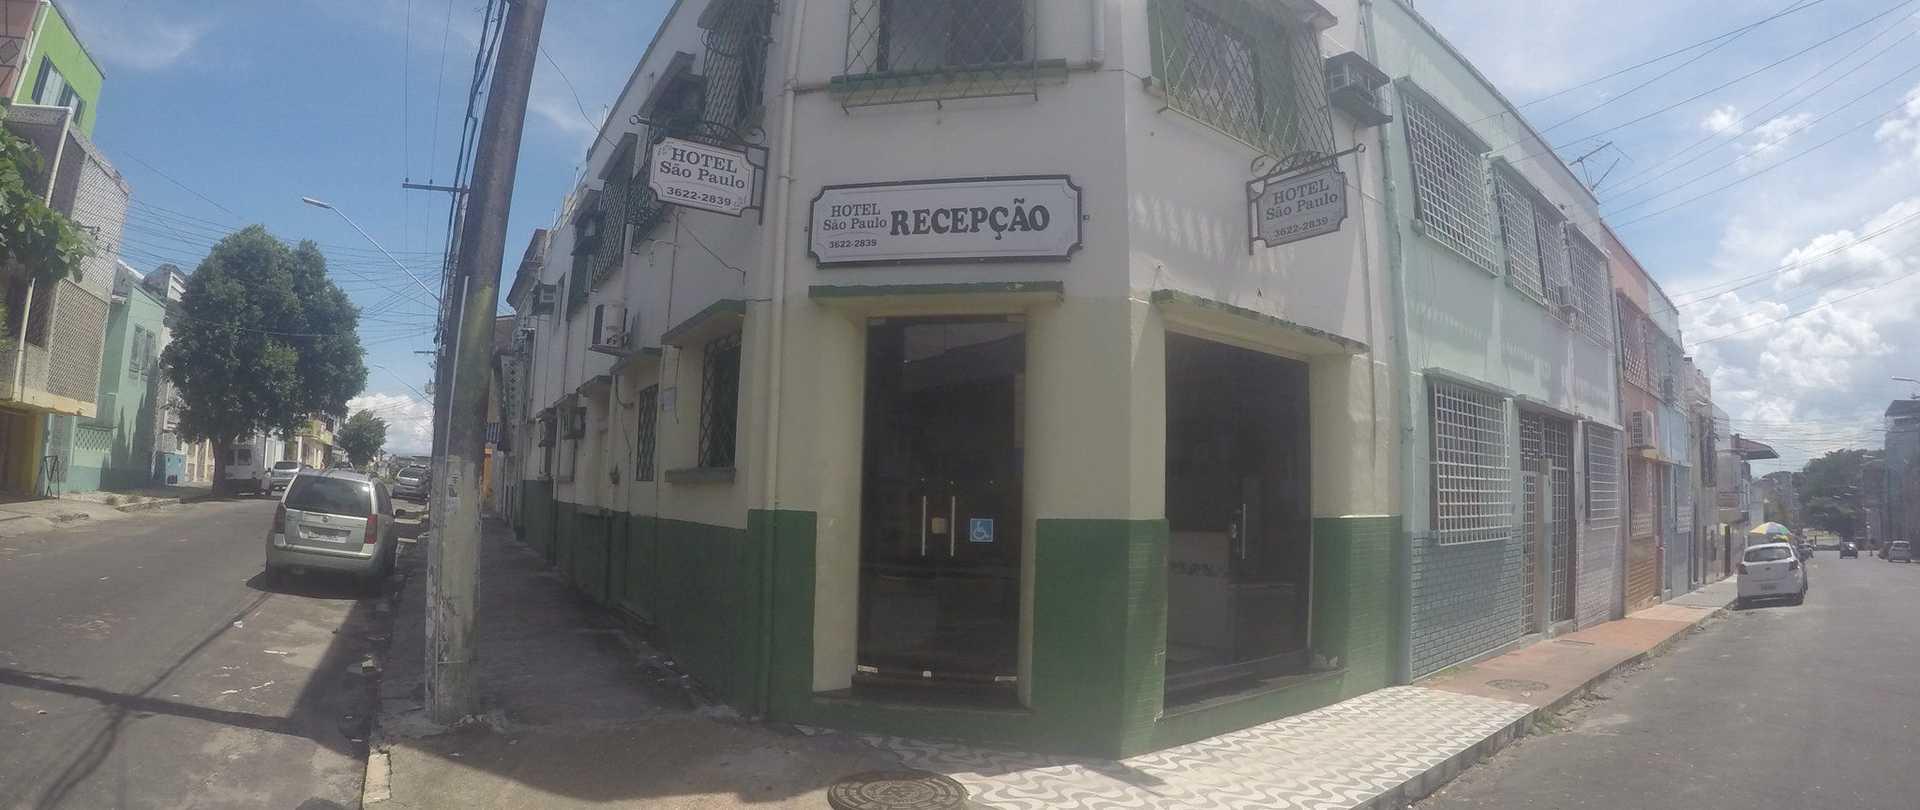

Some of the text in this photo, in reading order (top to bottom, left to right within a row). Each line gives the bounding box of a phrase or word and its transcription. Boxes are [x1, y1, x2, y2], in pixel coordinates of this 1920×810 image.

[671, 148, 737, 174] HOTEL
[660, 160, 745, 189] São Paulo
[666, 187, 731, 206] 3622-2839
[1274, 179, 1329, 205] HOTEL
[830, 203, 881, 219] HOTEL
[890, 198, 1050, 240] RECEPÇÃO
[1266, 193, 1338, 221] São Paulo
[823, 216, 887, 232] São Paulo
[829, 239, 877, 249] 3622-2839
